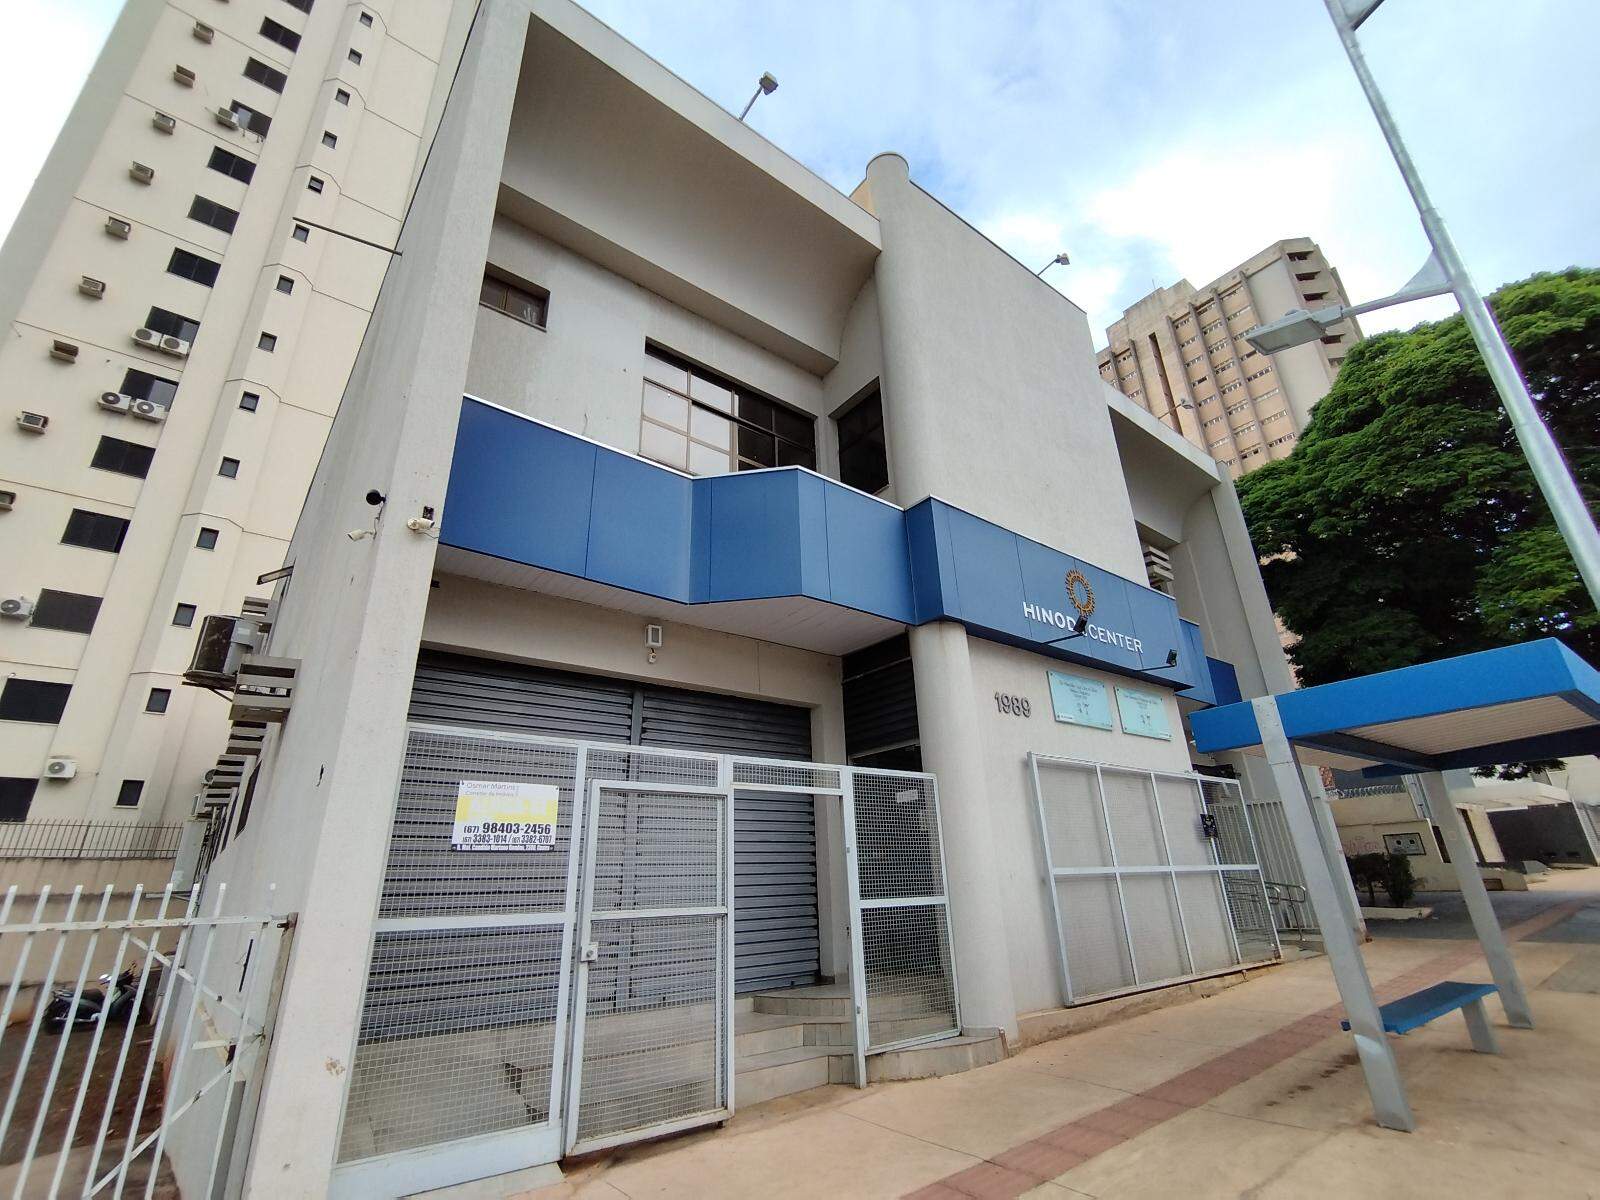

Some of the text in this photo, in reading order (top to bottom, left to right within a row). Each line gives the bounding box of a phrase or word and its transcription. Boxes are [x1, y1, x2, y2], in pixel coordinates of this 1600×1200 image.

[1022, 601, 1144, 653] HINOD CENTER
[994, 691, 1032, 718] 1989
[463, 822, 551, 835] (67) 98403-2456
